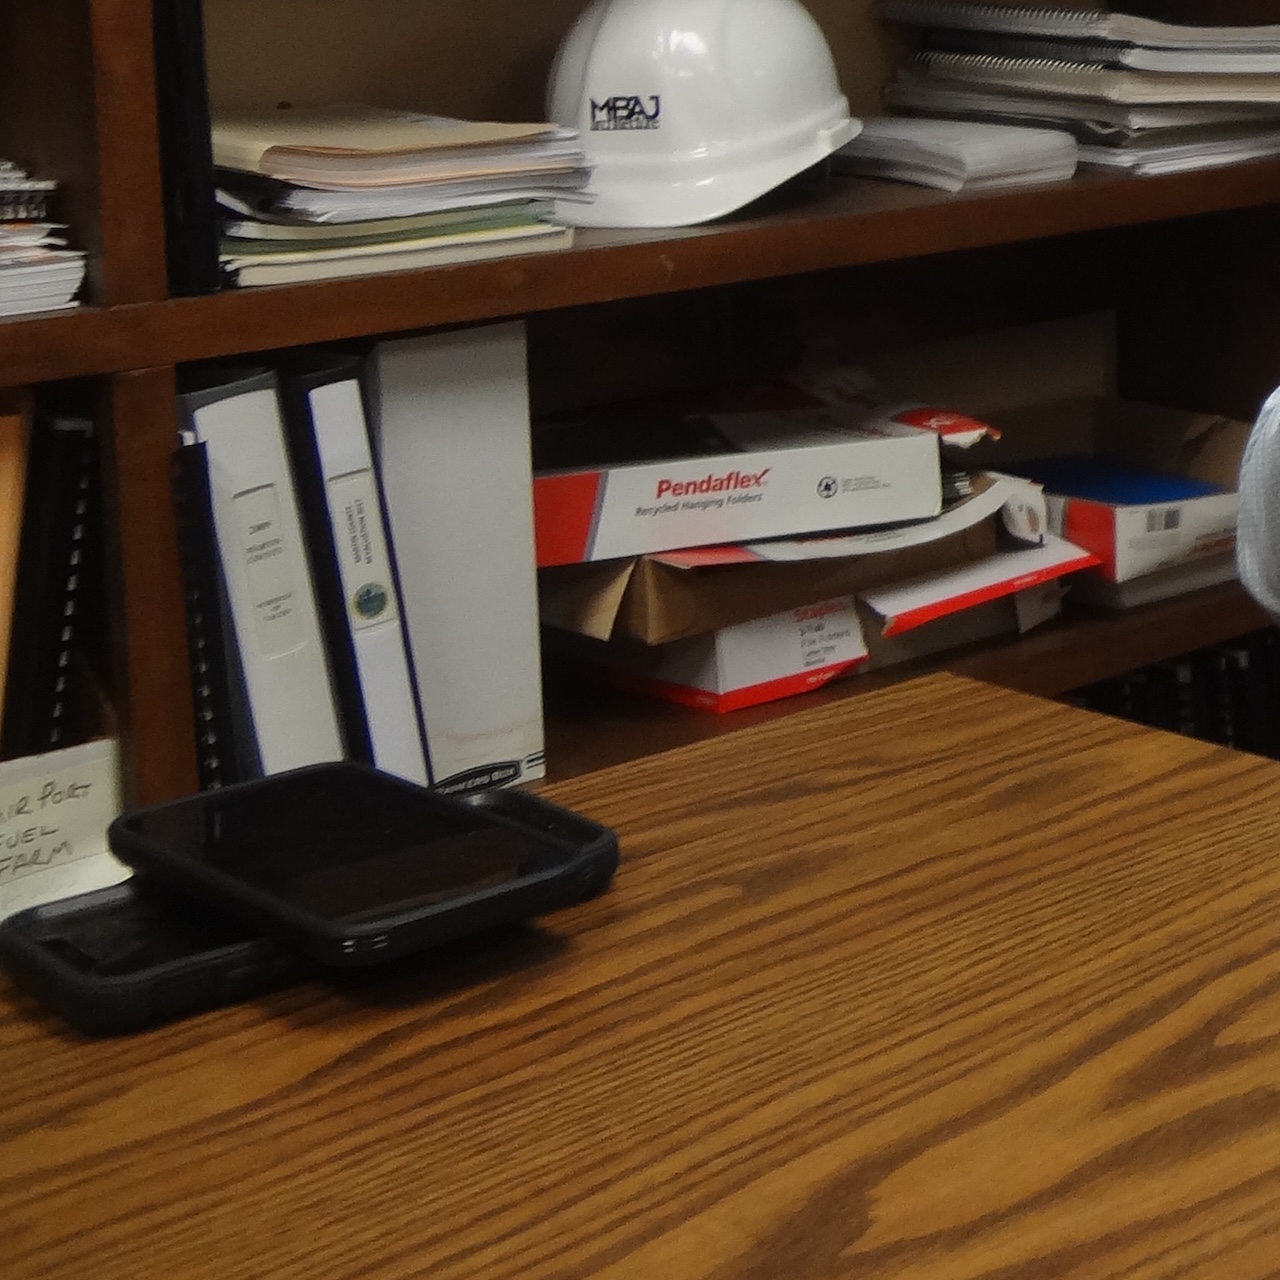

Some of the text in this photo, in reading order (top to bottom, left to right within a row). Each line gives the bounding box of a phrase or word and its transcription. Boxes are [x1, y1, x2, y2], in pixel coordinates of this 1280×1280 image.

[656, 468, 772, 499] Pendaflex
[634, 493, 763, 518] Recycled Hanging Folders
